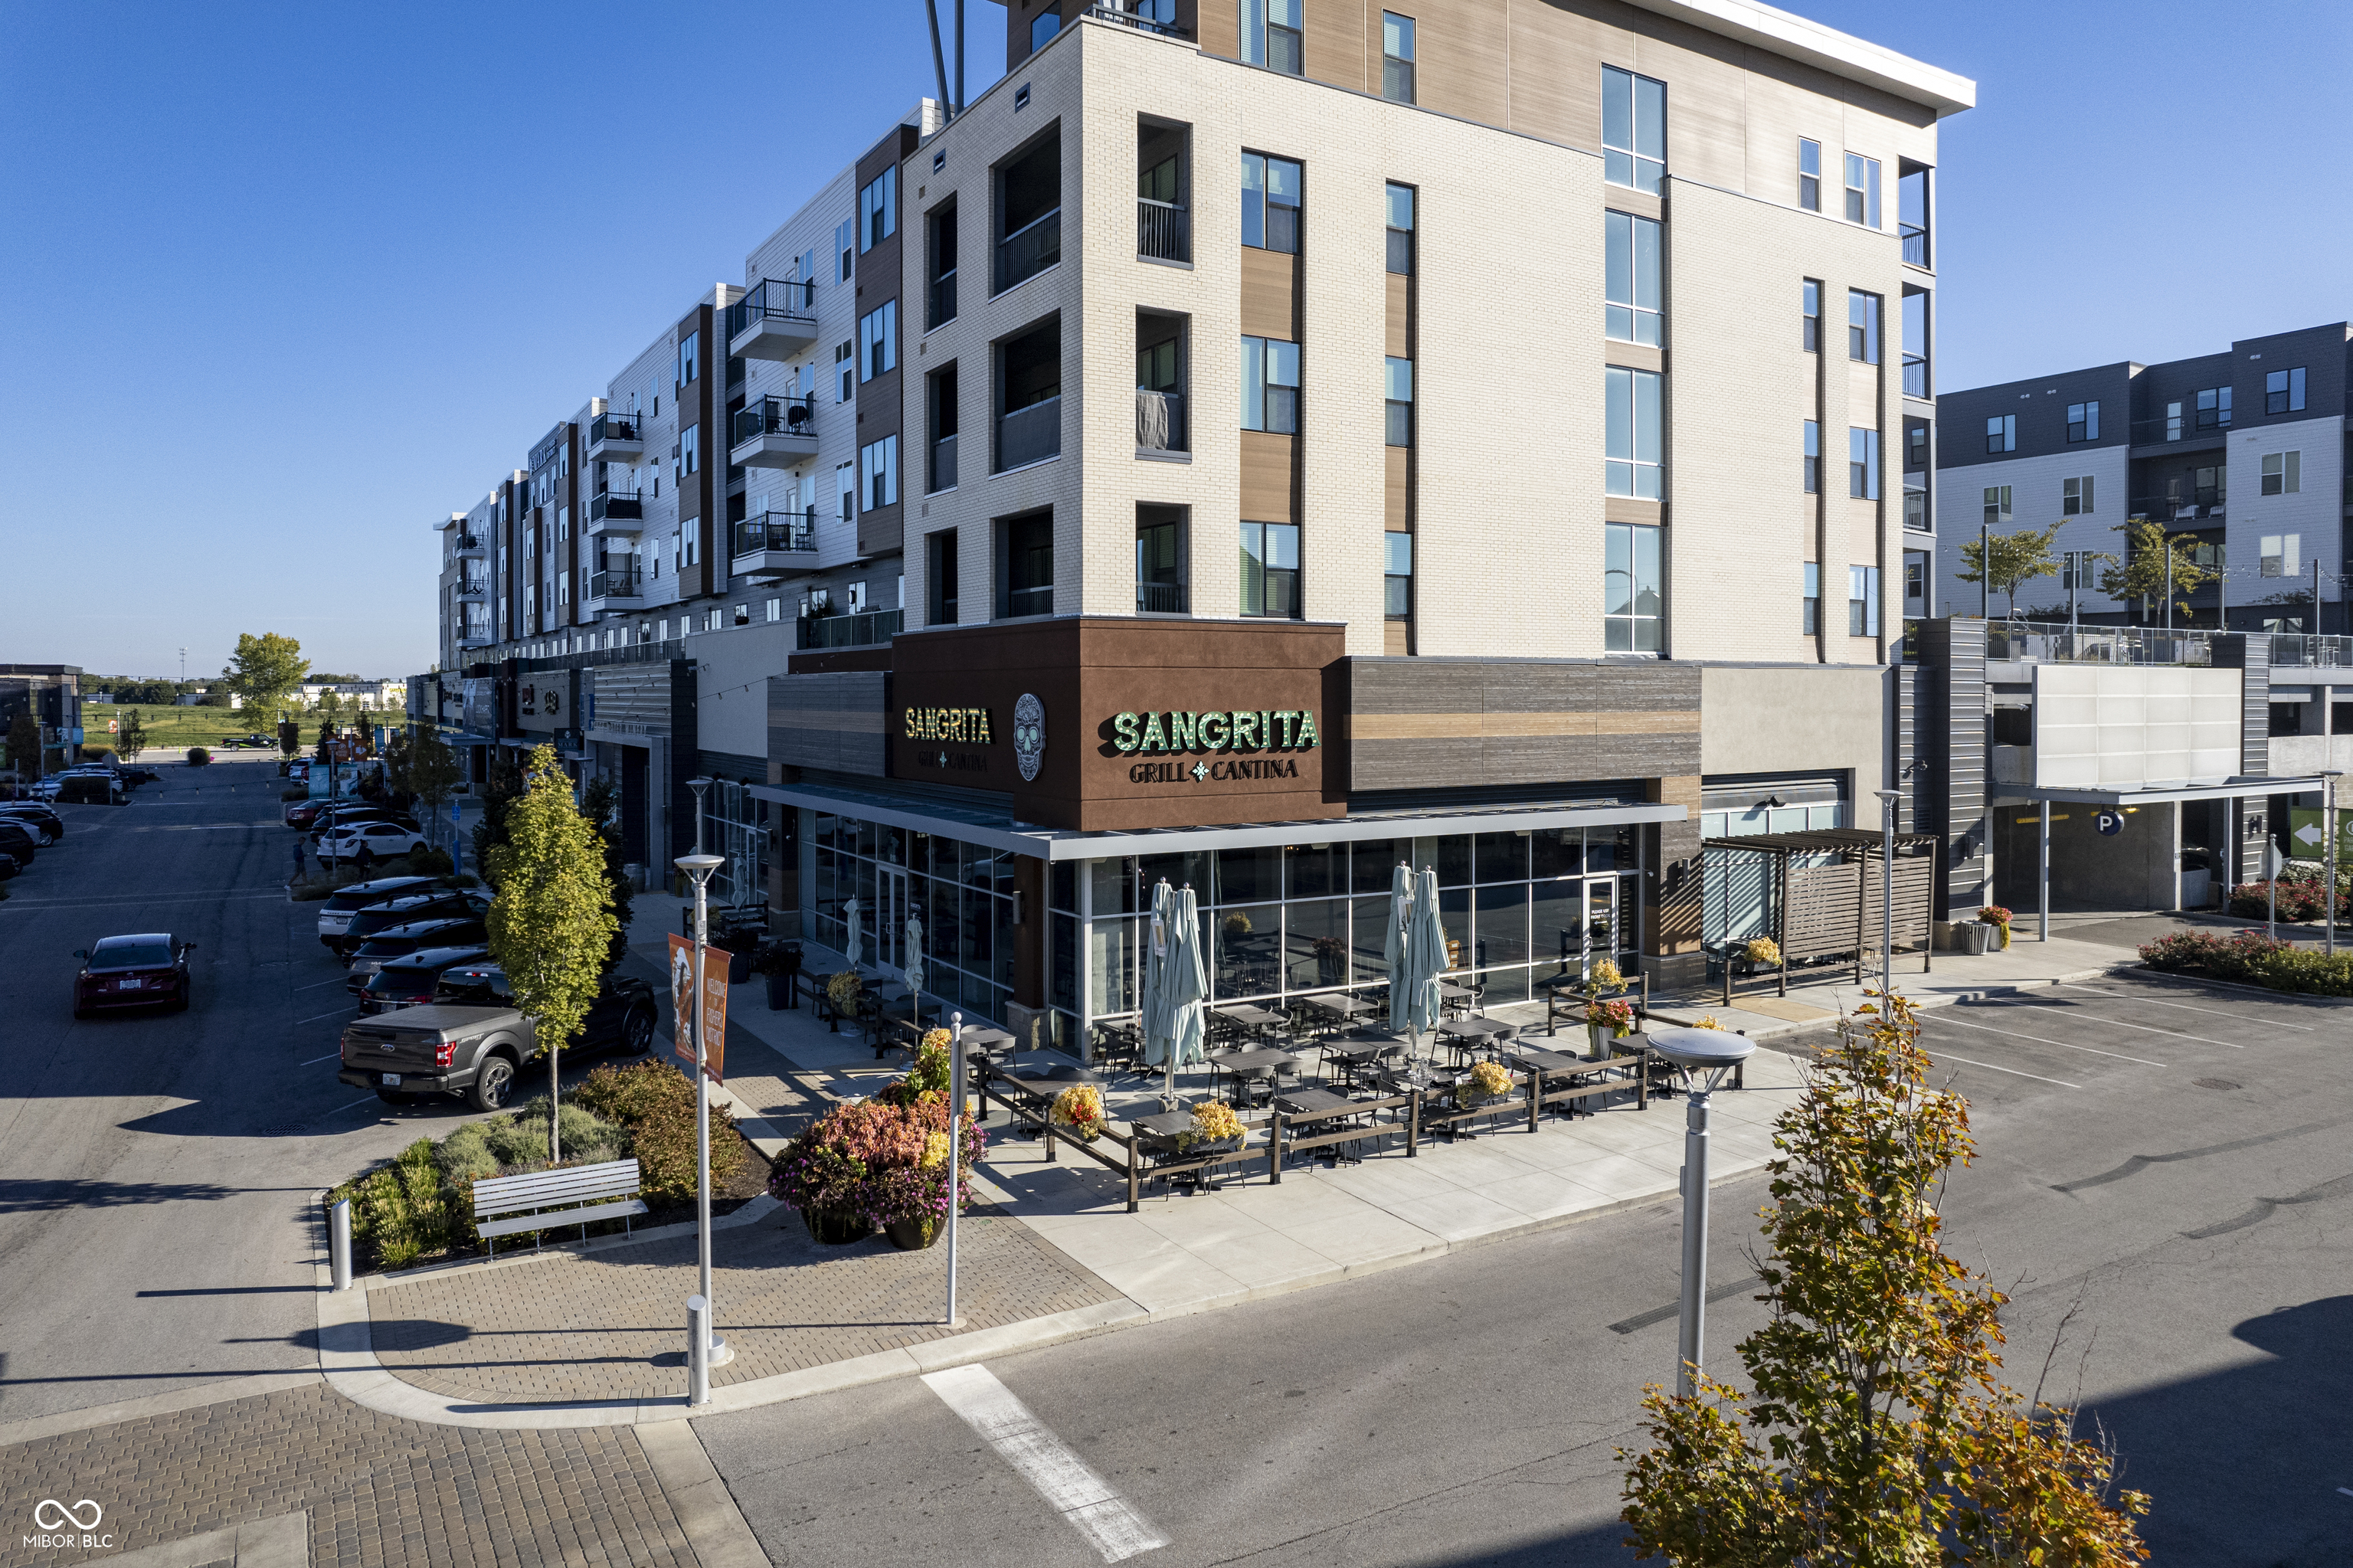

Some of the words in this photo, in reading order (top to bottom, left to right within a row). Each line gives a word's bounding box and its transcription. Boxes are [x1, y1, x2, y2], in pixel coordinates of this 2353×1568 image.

[905, 707, 991, 744] SANGRITA
[1114, 710, 1321, 751] SANGRITA
[918, 750, 941, 768] GRILL
[949, 752, 988, 772] CANTINA
[1129, 761, 1190, 784] GRILL
[1210, 759, 1300, 781] CANTINA
[2099, 816, 2112, 831] P
[707, 977, 726, 998] WELCOME
[707, 1007, 723, 1028] FISHERS
[706, 1026, 722, 1046] DISTRICT
